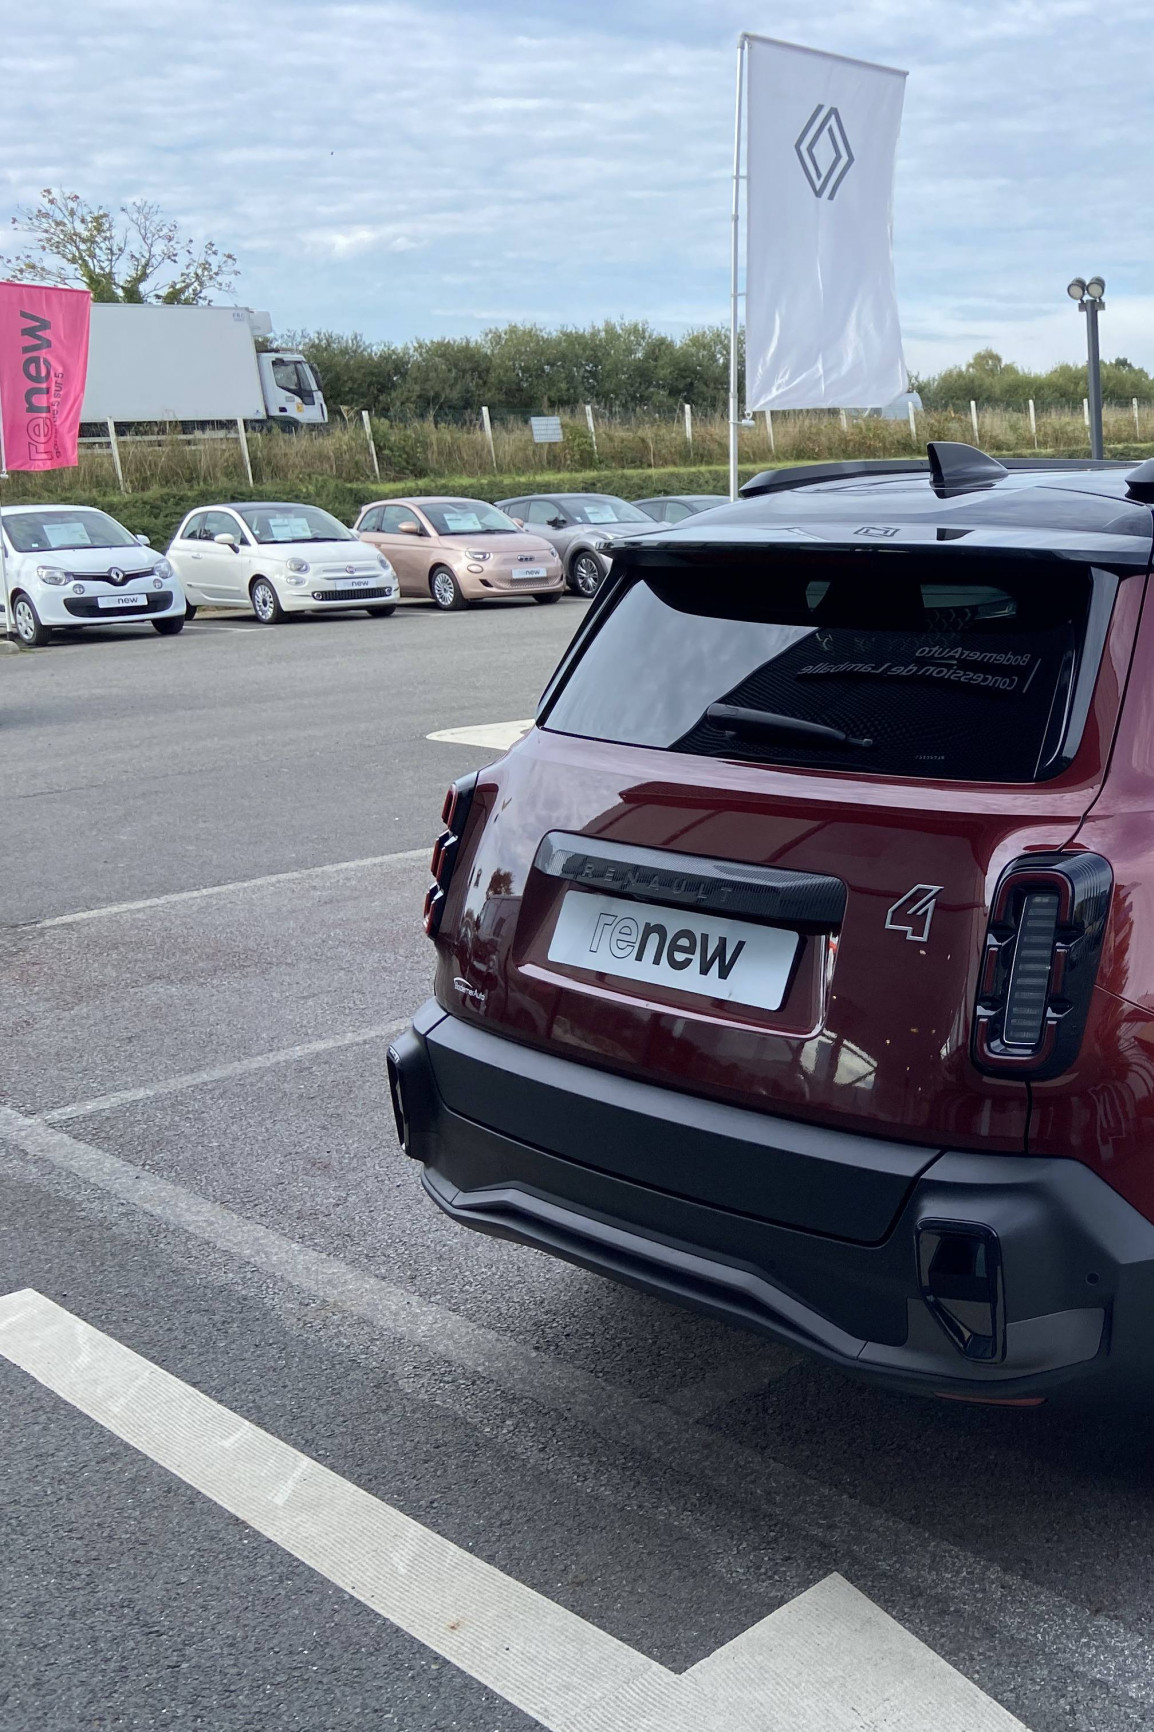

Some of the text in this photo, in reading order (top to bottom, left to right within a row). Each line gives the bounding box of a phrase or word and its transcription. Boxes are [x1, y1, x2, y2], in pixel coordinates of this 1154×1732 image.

[19, 310, 54, 461] renew
[53, 380, 63, 398] sur
[581, 861, 733, 902] RENAULT
[589, 912, 747, 980] renew
